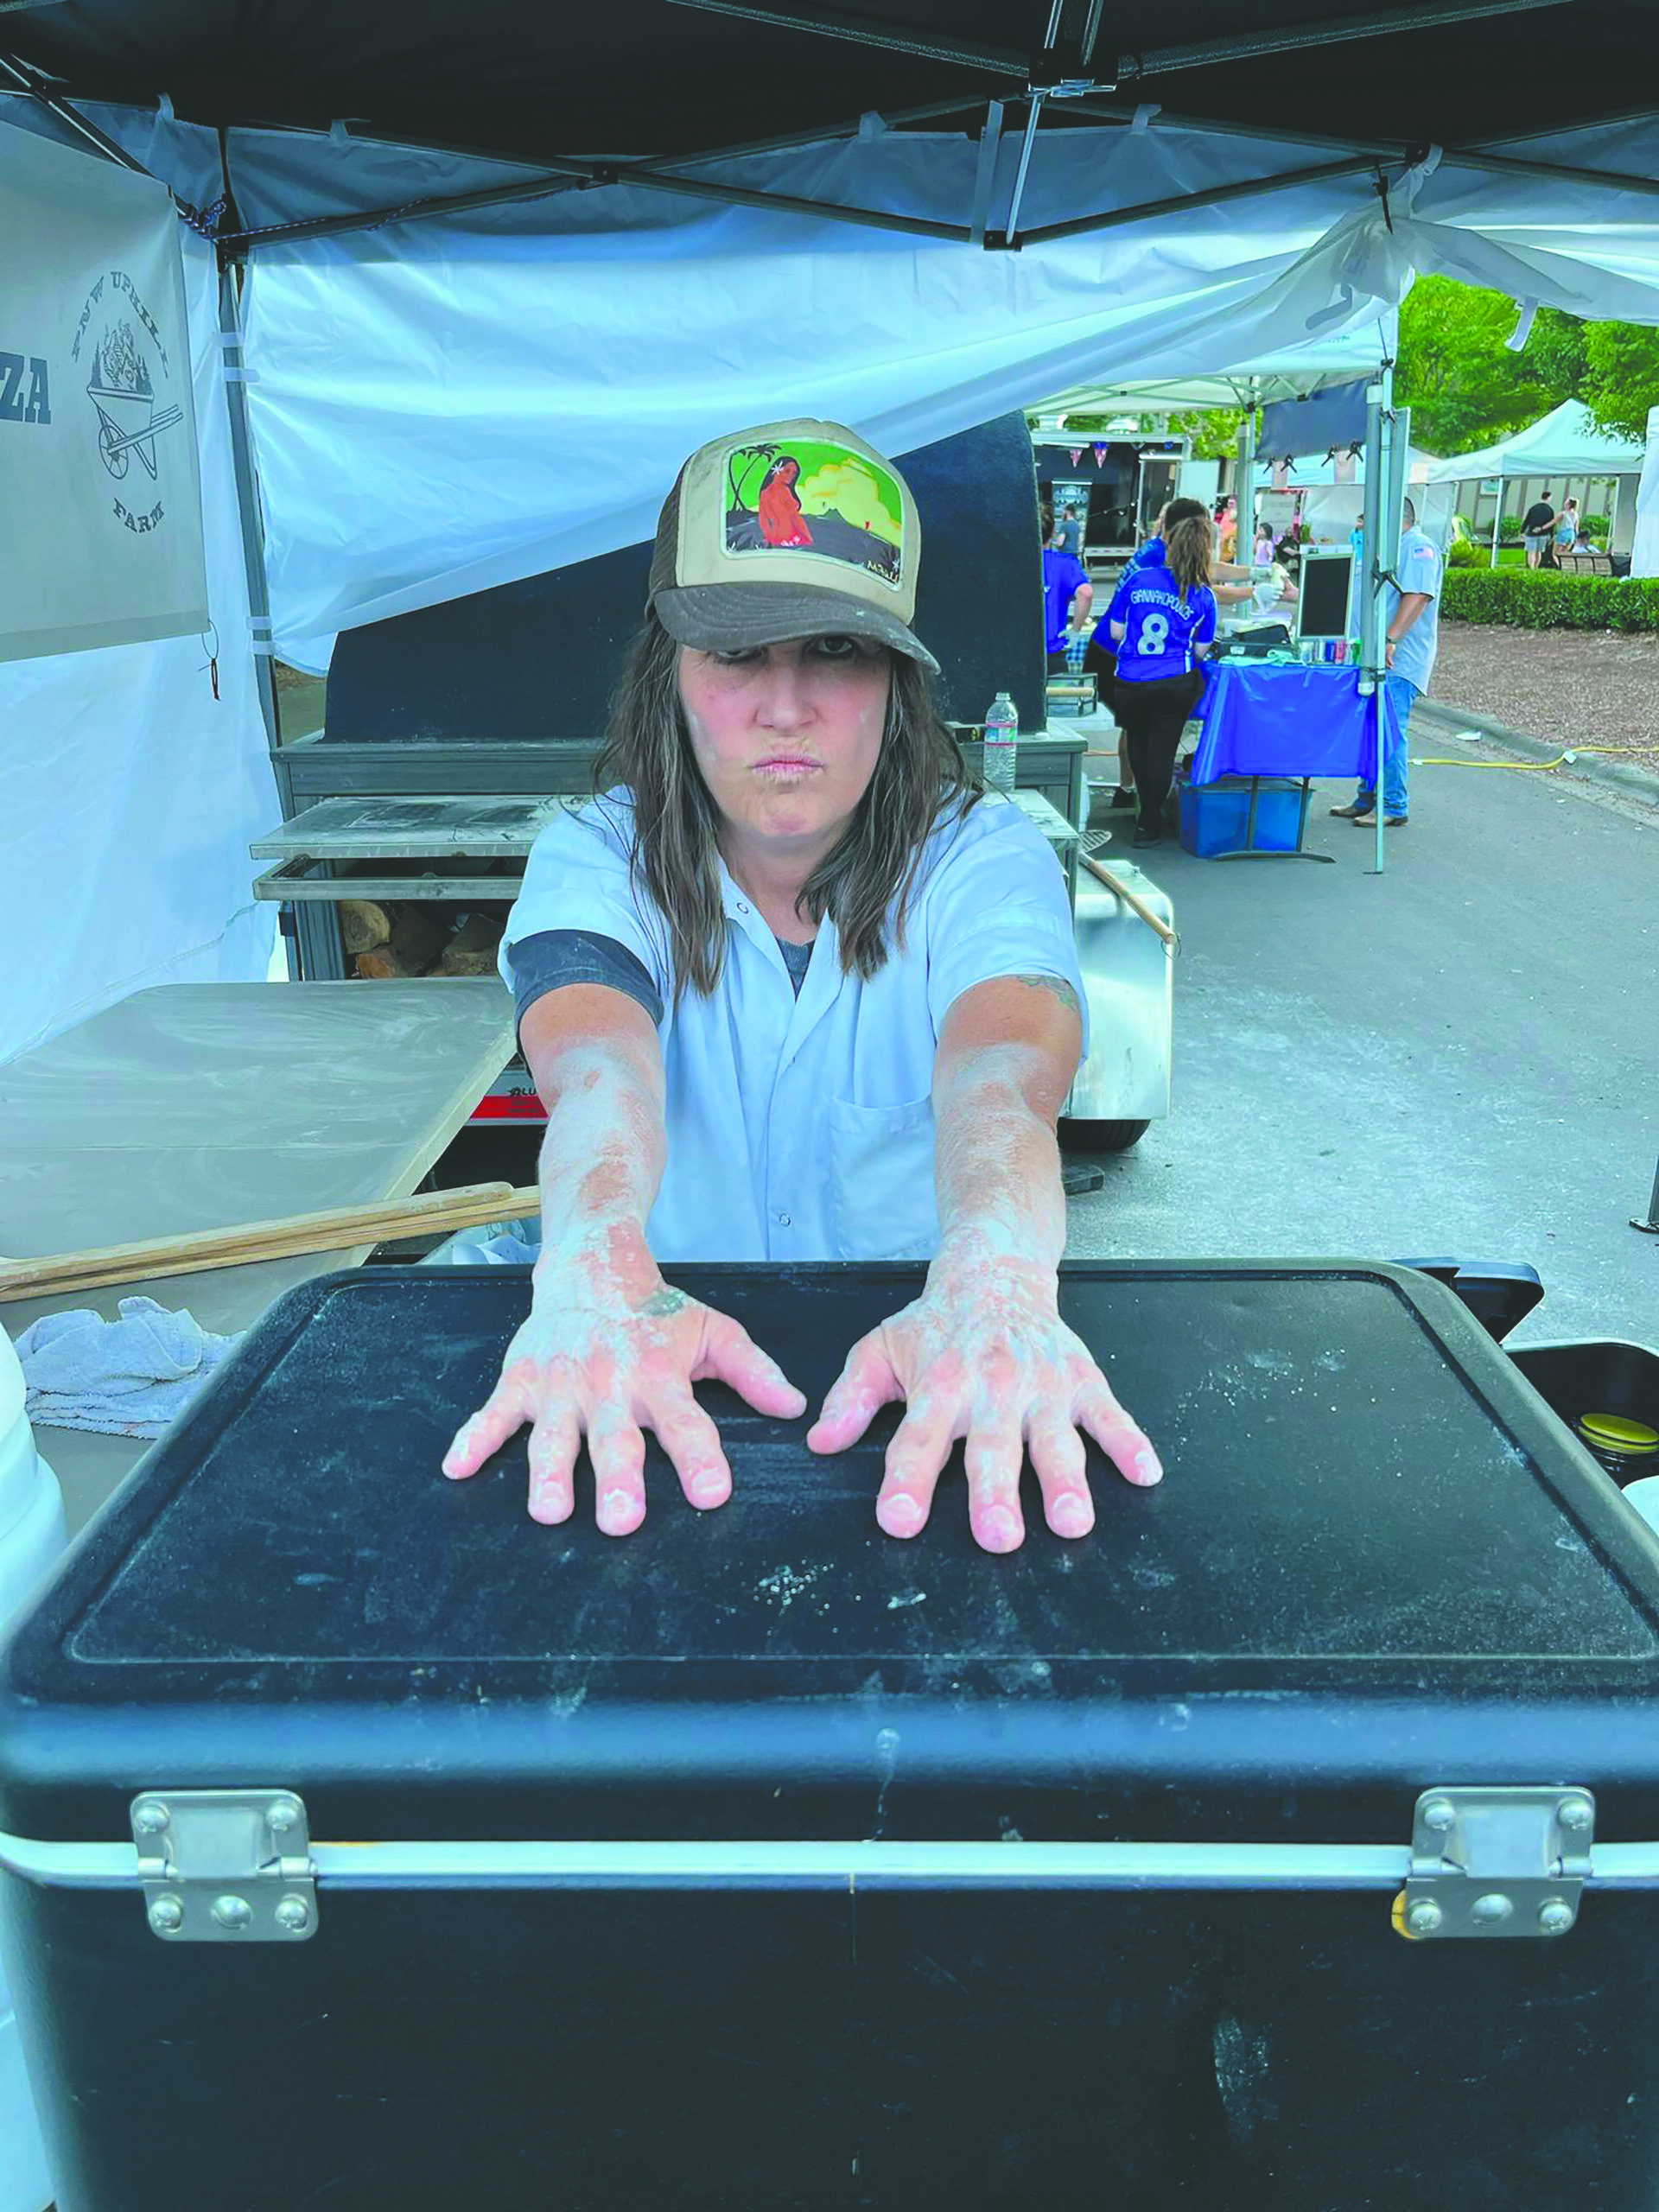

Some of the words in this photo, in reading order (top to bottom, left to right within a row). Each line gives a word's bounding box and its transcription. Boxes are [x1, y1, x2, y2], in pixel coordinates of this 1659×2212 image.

[111, 271, 168, 378] UPHILL
[113, 497, 164, 533] FARM
[1137, 613, 1169, 655] 8
